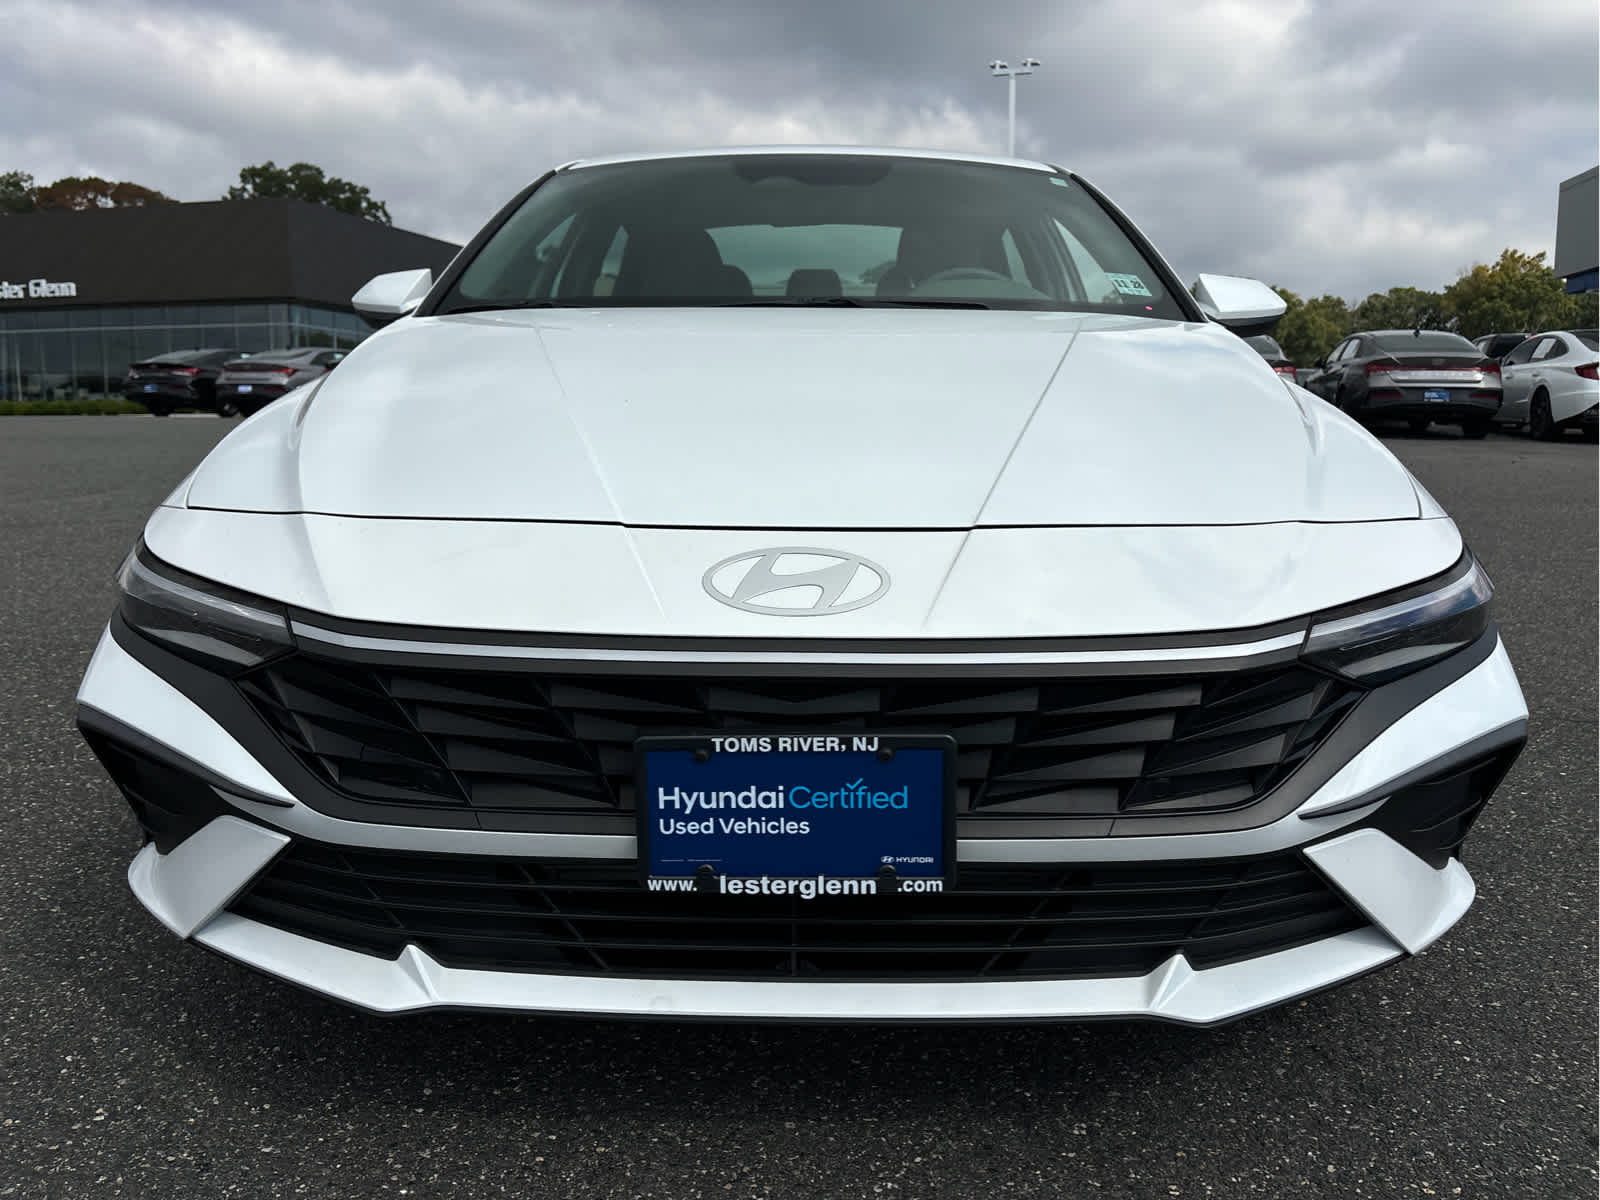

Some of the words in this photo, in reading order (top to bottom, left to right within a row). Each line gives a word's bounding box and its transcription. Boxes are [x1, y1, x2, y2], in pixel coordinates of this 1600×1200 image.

[28, 279, 77, 297] Glenn
[711, 737, 772, 753] TOMS
[778, 736, 847, 752] RIVER,
[852, 736, 879, 752] NJ
[657, 785, 785, 815] Hyundai
[788, 777, 909, 810] Certified
[658, 818, 715, 835] Used
[718, 816, 811, 835] Vehicles
[895, 856, 935, 864] HYUNDAI
